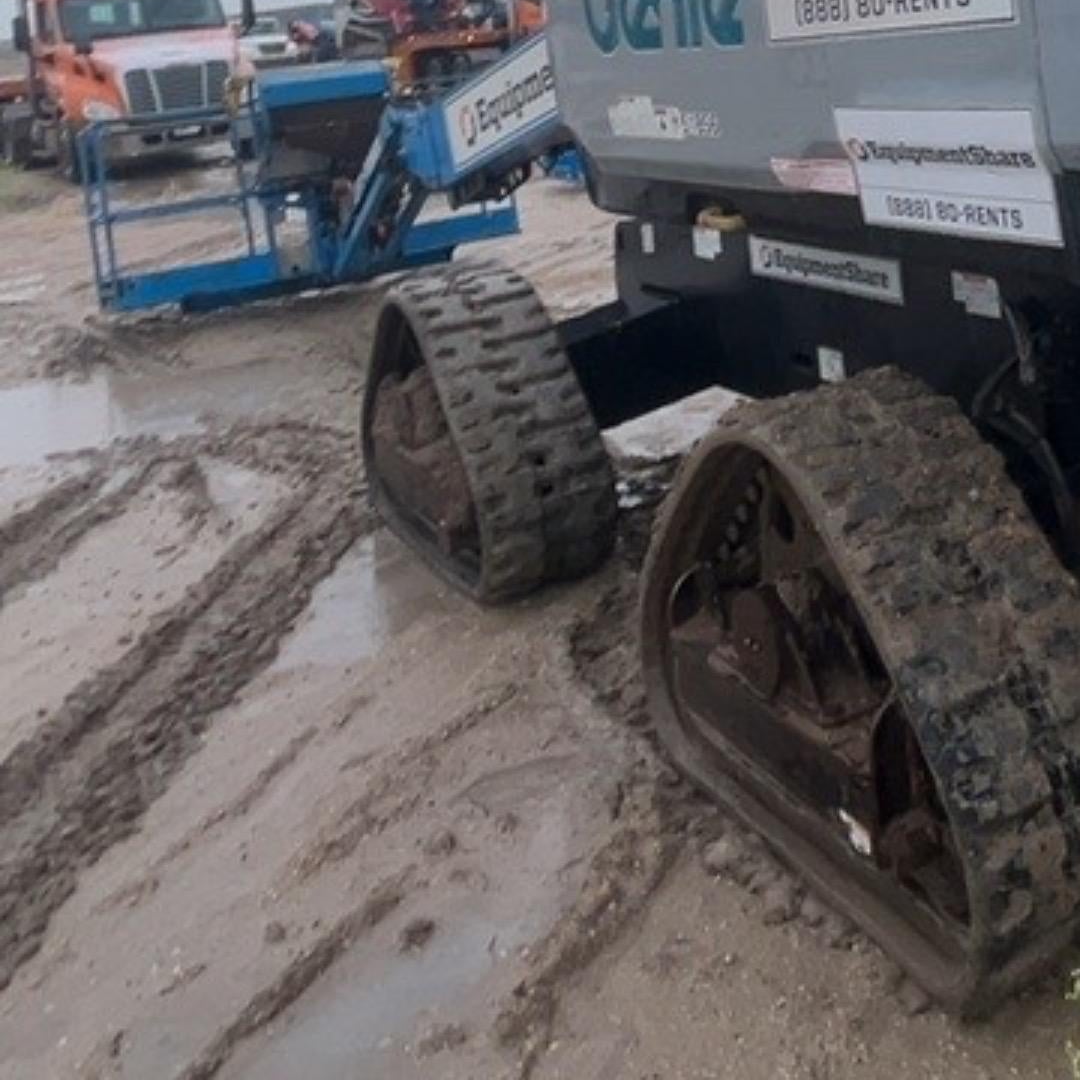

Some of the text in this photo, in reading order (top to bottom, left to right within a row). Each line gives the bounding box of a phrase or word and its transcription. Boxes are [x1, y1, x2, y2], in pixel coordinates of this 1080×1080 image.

[866, 140, 1036, 169] EquipmentShare
[886, 195, 1024, 229] (888) 80-RENTS
